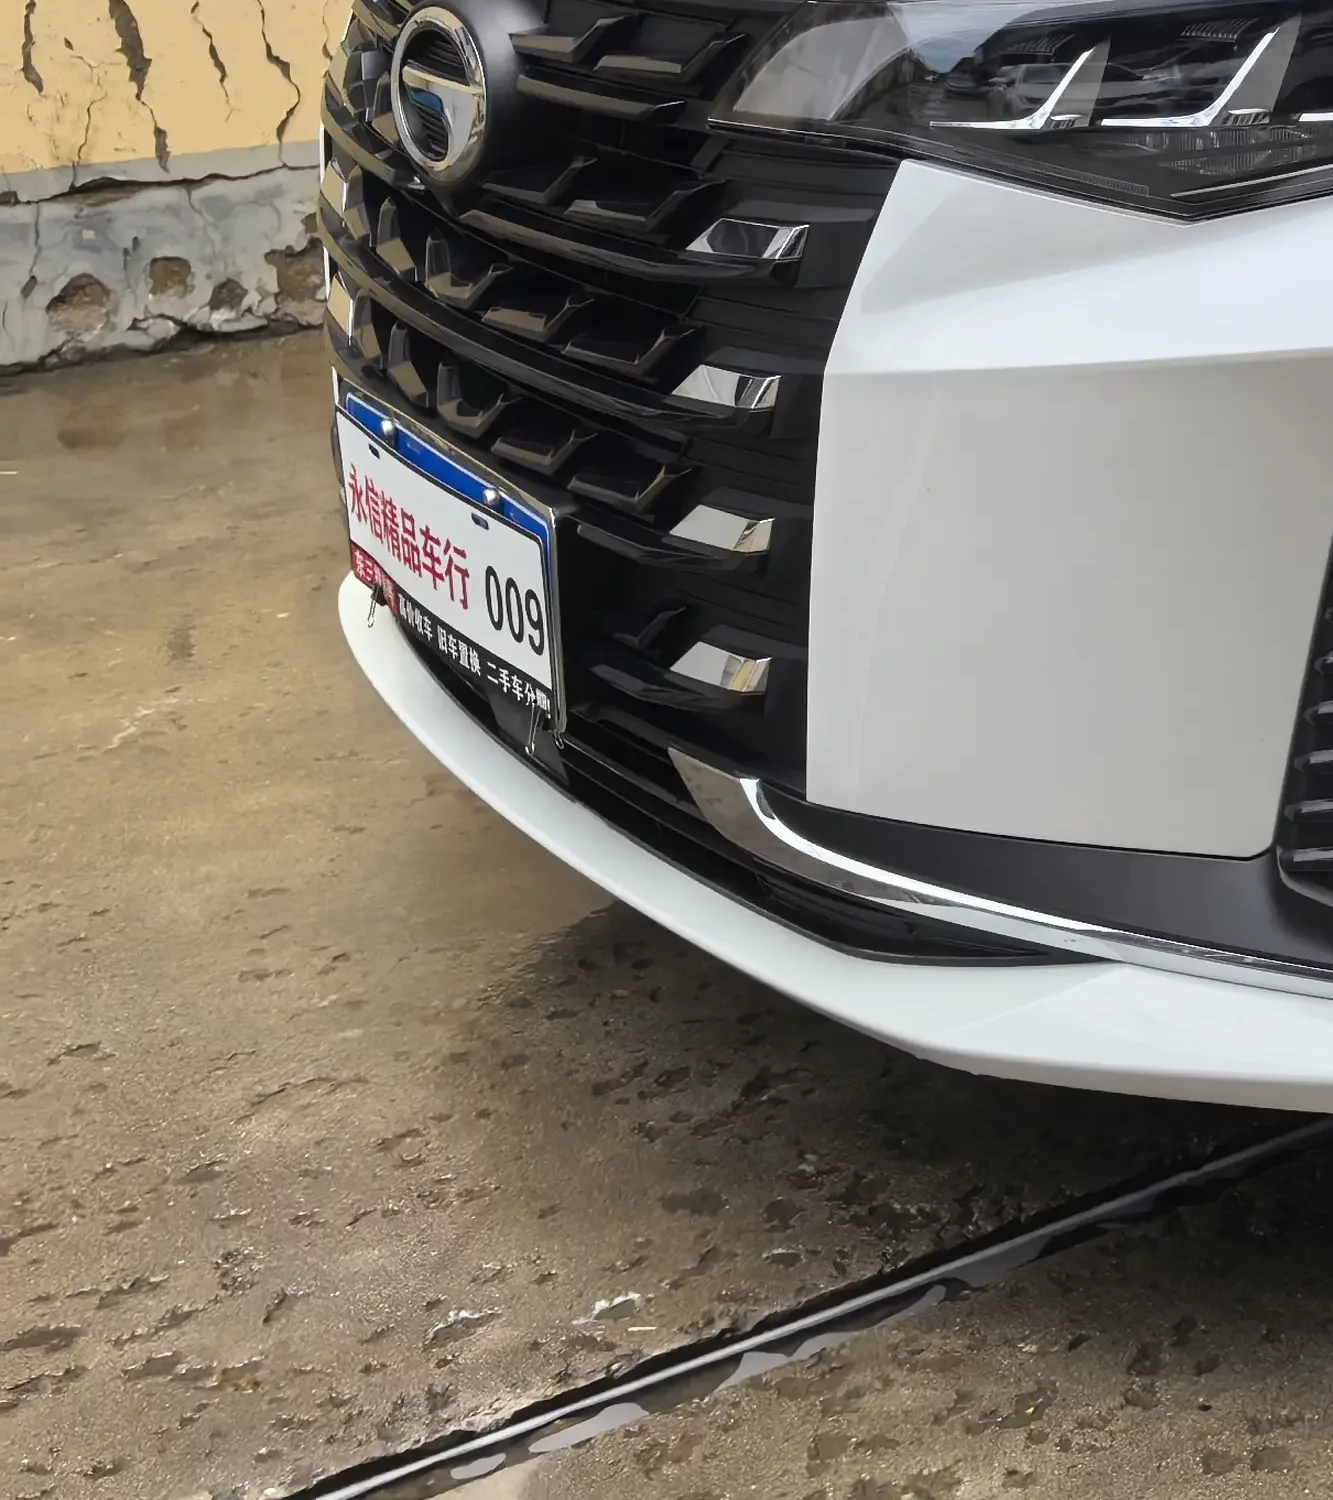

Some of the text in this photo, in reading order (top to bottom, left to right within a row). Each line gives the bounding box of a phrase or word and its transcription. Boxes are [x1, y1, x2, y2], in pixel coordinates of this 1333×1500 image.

[348, 464, 470, 610] 永信精品车行
[484, 565, 545, 656] 009
